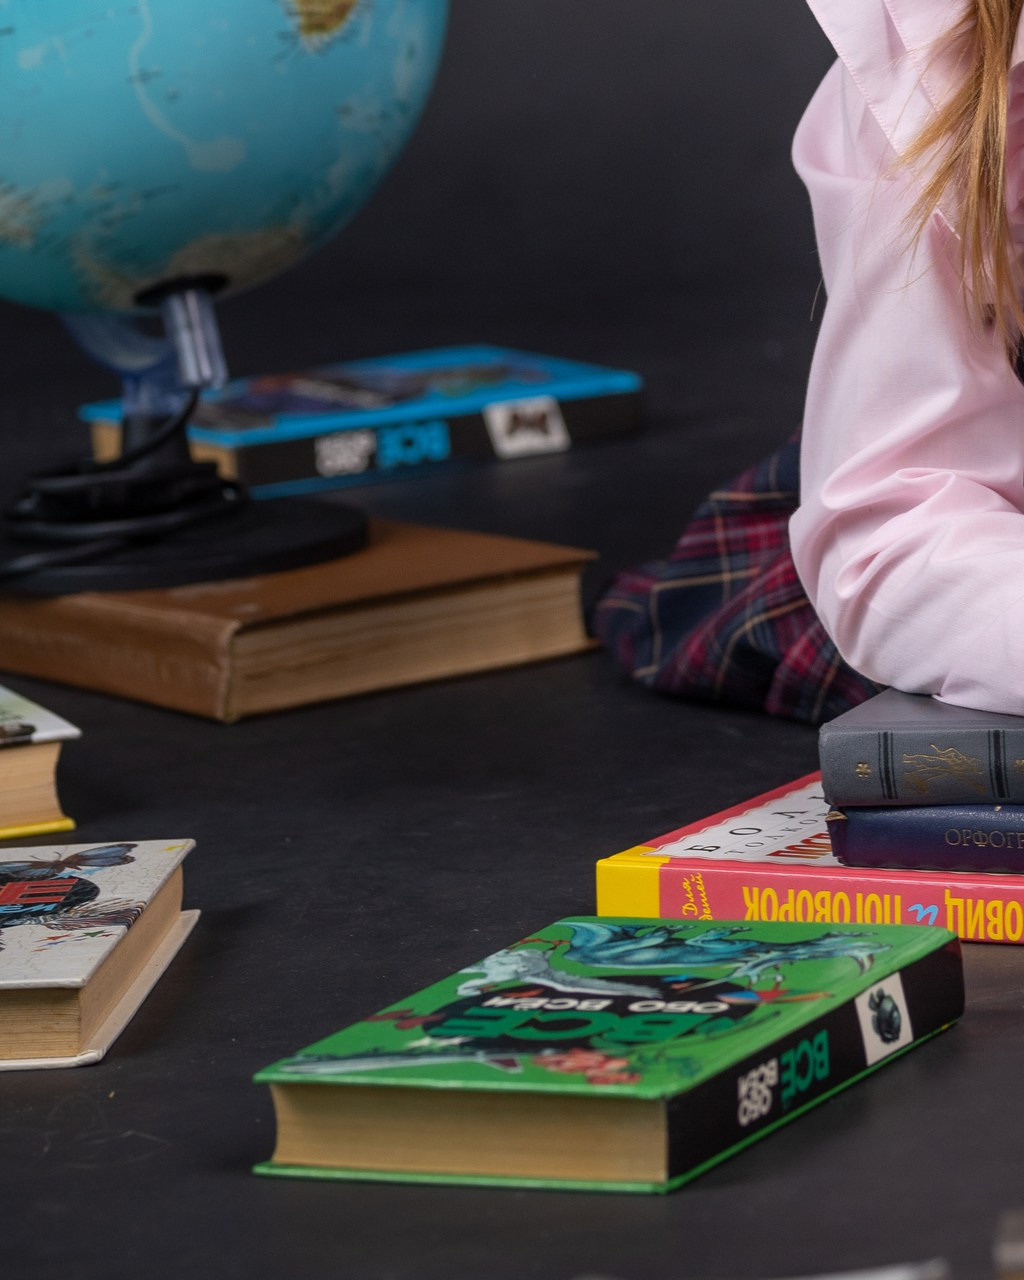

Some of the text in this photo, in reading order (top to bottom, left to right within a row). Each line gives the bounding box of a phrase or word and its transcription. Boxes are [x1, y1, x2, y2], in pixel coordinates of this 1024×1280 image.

[681, 877, 698, 915] Для
[690, 872, 713, 920] детей
[742, 887, 902, 925] ПОГОВОРОК
[628, 1000, 730, 1014] ОБО
